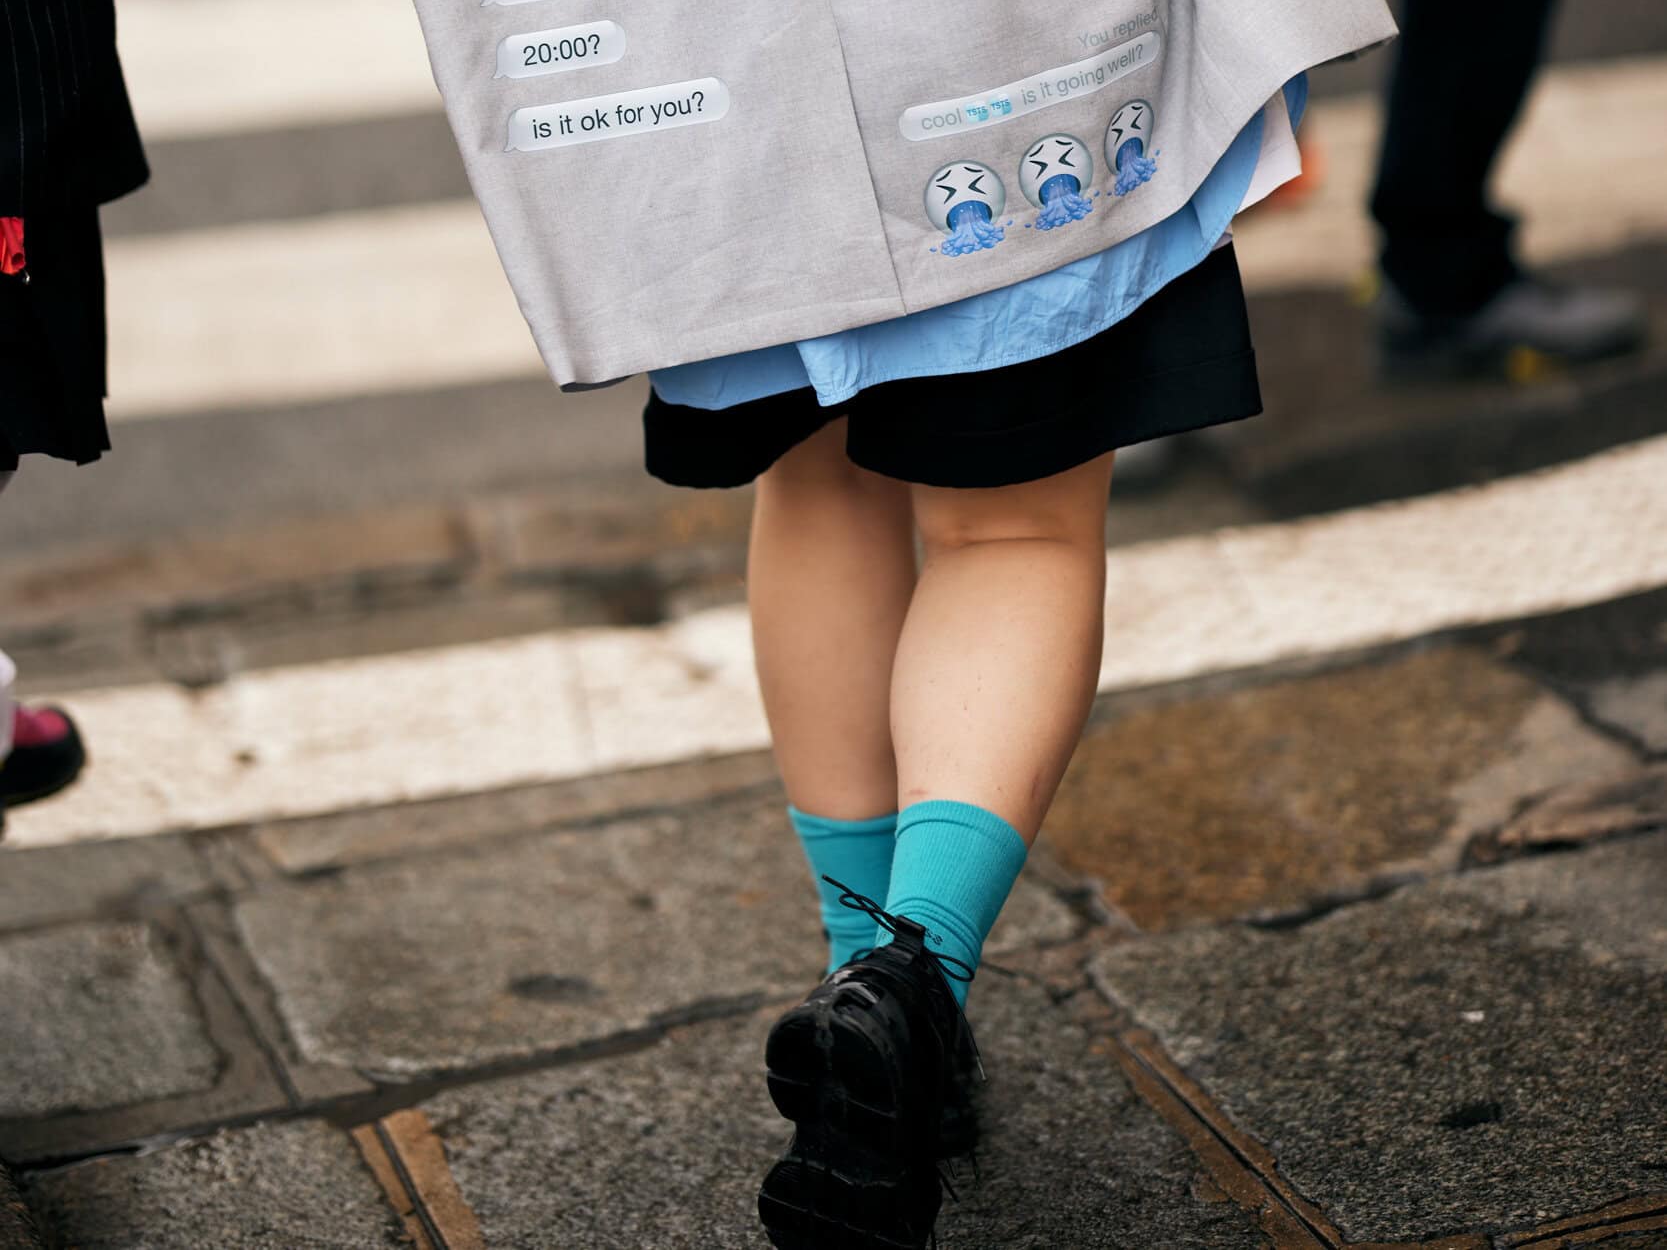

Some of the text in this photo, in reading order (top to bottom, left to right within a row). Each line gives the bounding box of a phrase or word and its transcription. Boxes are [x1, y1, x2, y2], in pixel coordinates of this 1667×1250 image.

[1078, 6, 1158, 48] You replied
[522, 33, 602, 67] 20:00?
[921, 108, 963, 132] cool
[1021, 88, 1038, 106] is
[1040, 81, 1054, 101] it
[1056, 67, 1106, 97] going
[1107, 43, 1145, 76] well?
[532, 91, 705, 140] is it ok for you?
